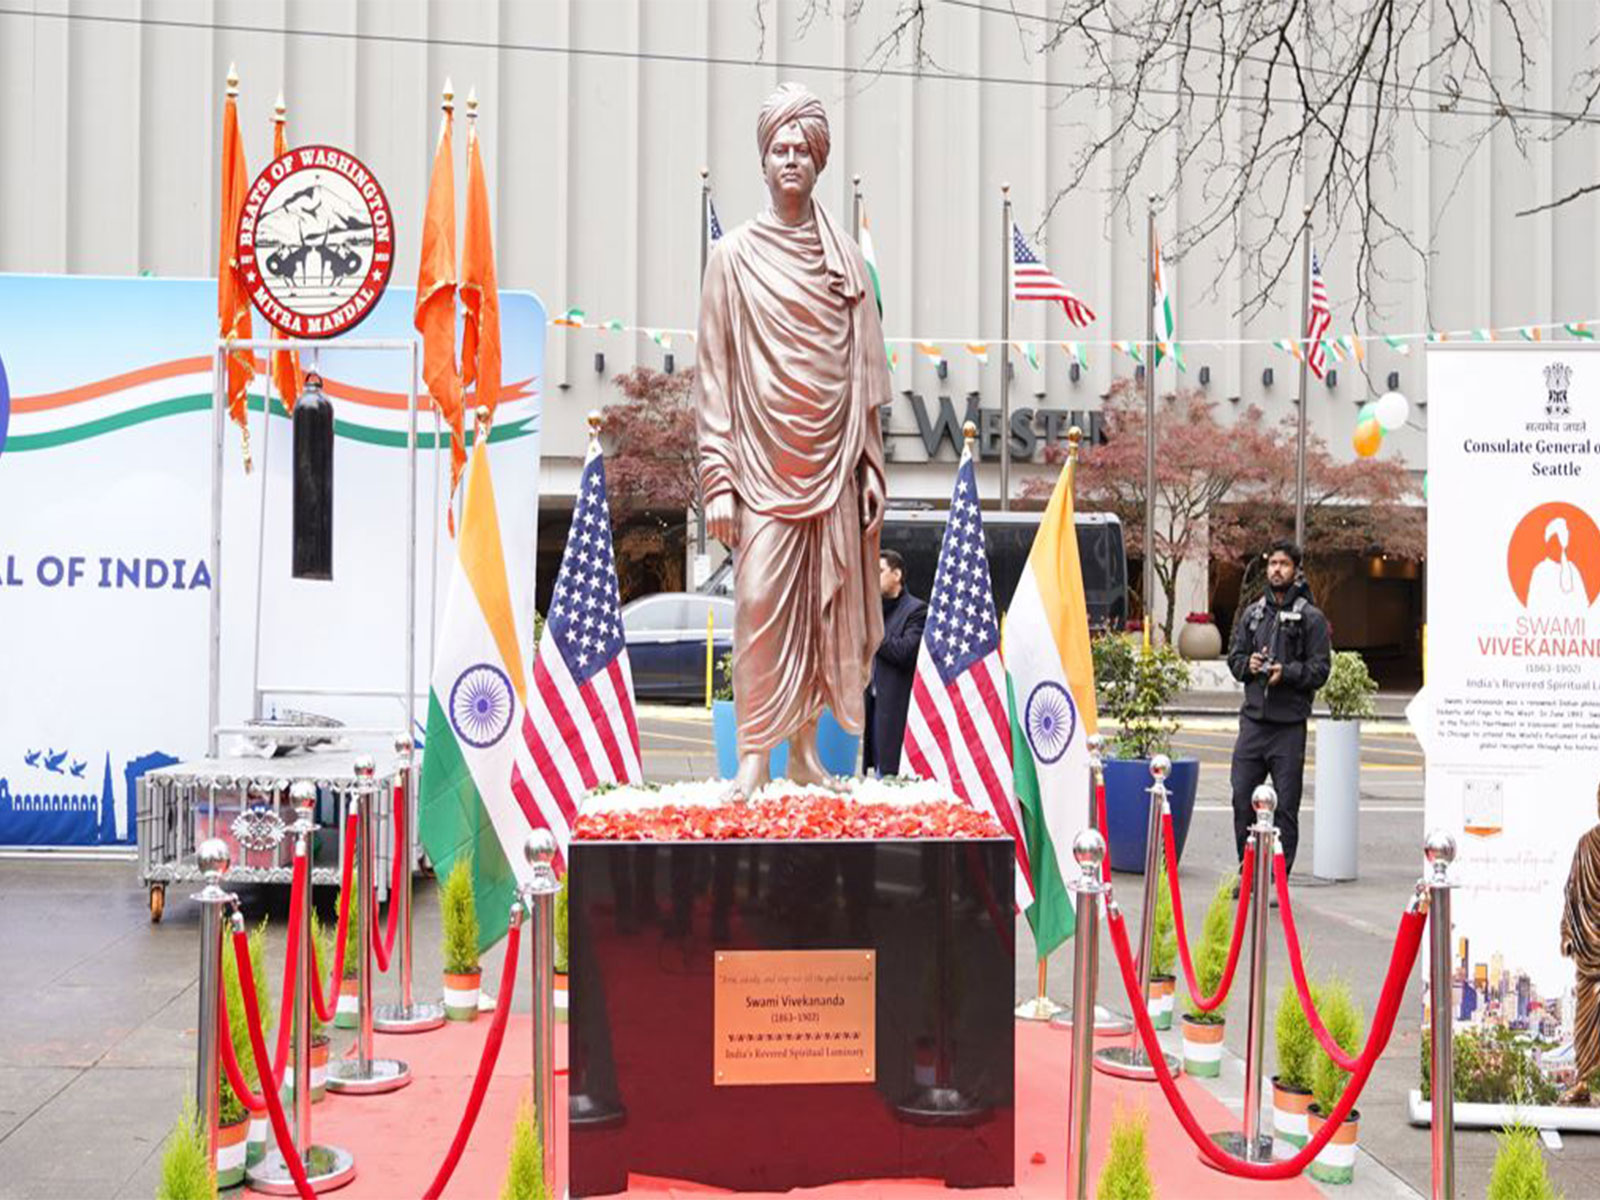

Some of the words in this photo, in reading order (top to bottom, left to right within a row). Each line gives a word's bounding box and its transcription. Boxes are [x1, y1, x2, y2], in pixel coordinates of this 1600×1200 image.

[240, 178, 271, 245] BEATS
[271, 157, 294, 179] OF
[300, 150, 390, 242] WASHINGTON
[253, 287, 302, 331] MITRA
[307, 288, 375, 333] MANDAL
[1463, 438, 1533, 454] Consulate
[1536, 439, 1591, 454] General
[1532, 461, 1582, 477] Seattle
[0, 556, 23, 585] L
[37, 556, 85, 587] OF
[98, 557, 212, 590] INDIA
[1516, 617, 1586, 636] SWAMI
[1466, 679, 1500, 688] India's
[1502, 679, 1545, 689] Revered
[1547, 679, 1590, 692] Spiritual
[746, 996, 779, 1007] Swami
[782, 994, 845, 1007] Vivekananda
